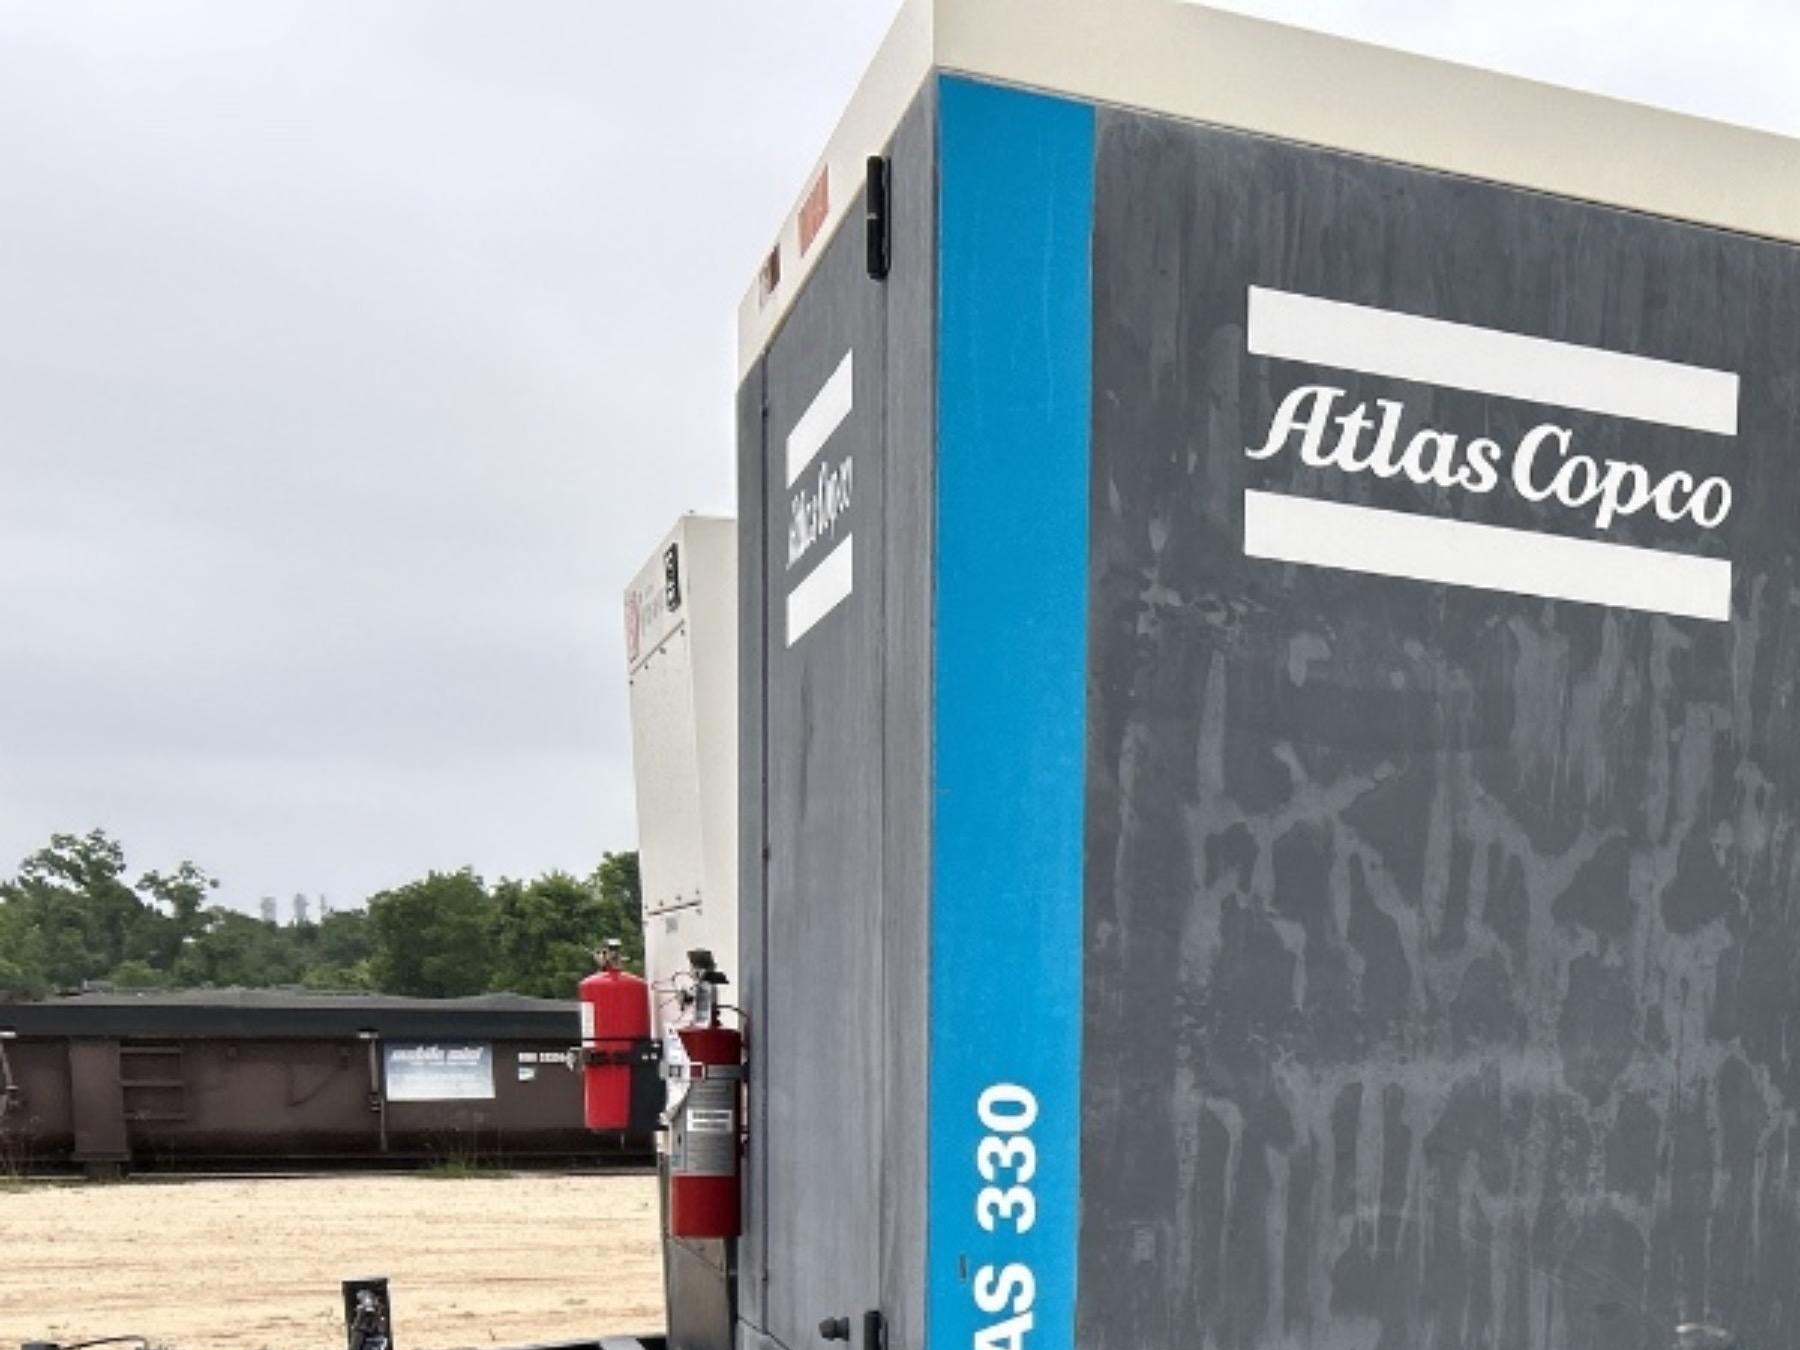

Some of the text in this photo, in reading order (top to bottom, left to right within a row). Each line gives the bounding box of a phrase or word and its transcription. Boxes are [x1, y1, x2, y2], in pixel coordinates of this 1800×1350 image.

[1245, 385, 1733, 529] Atlas Copco
[976, 1082, 1039, 1235] 330
